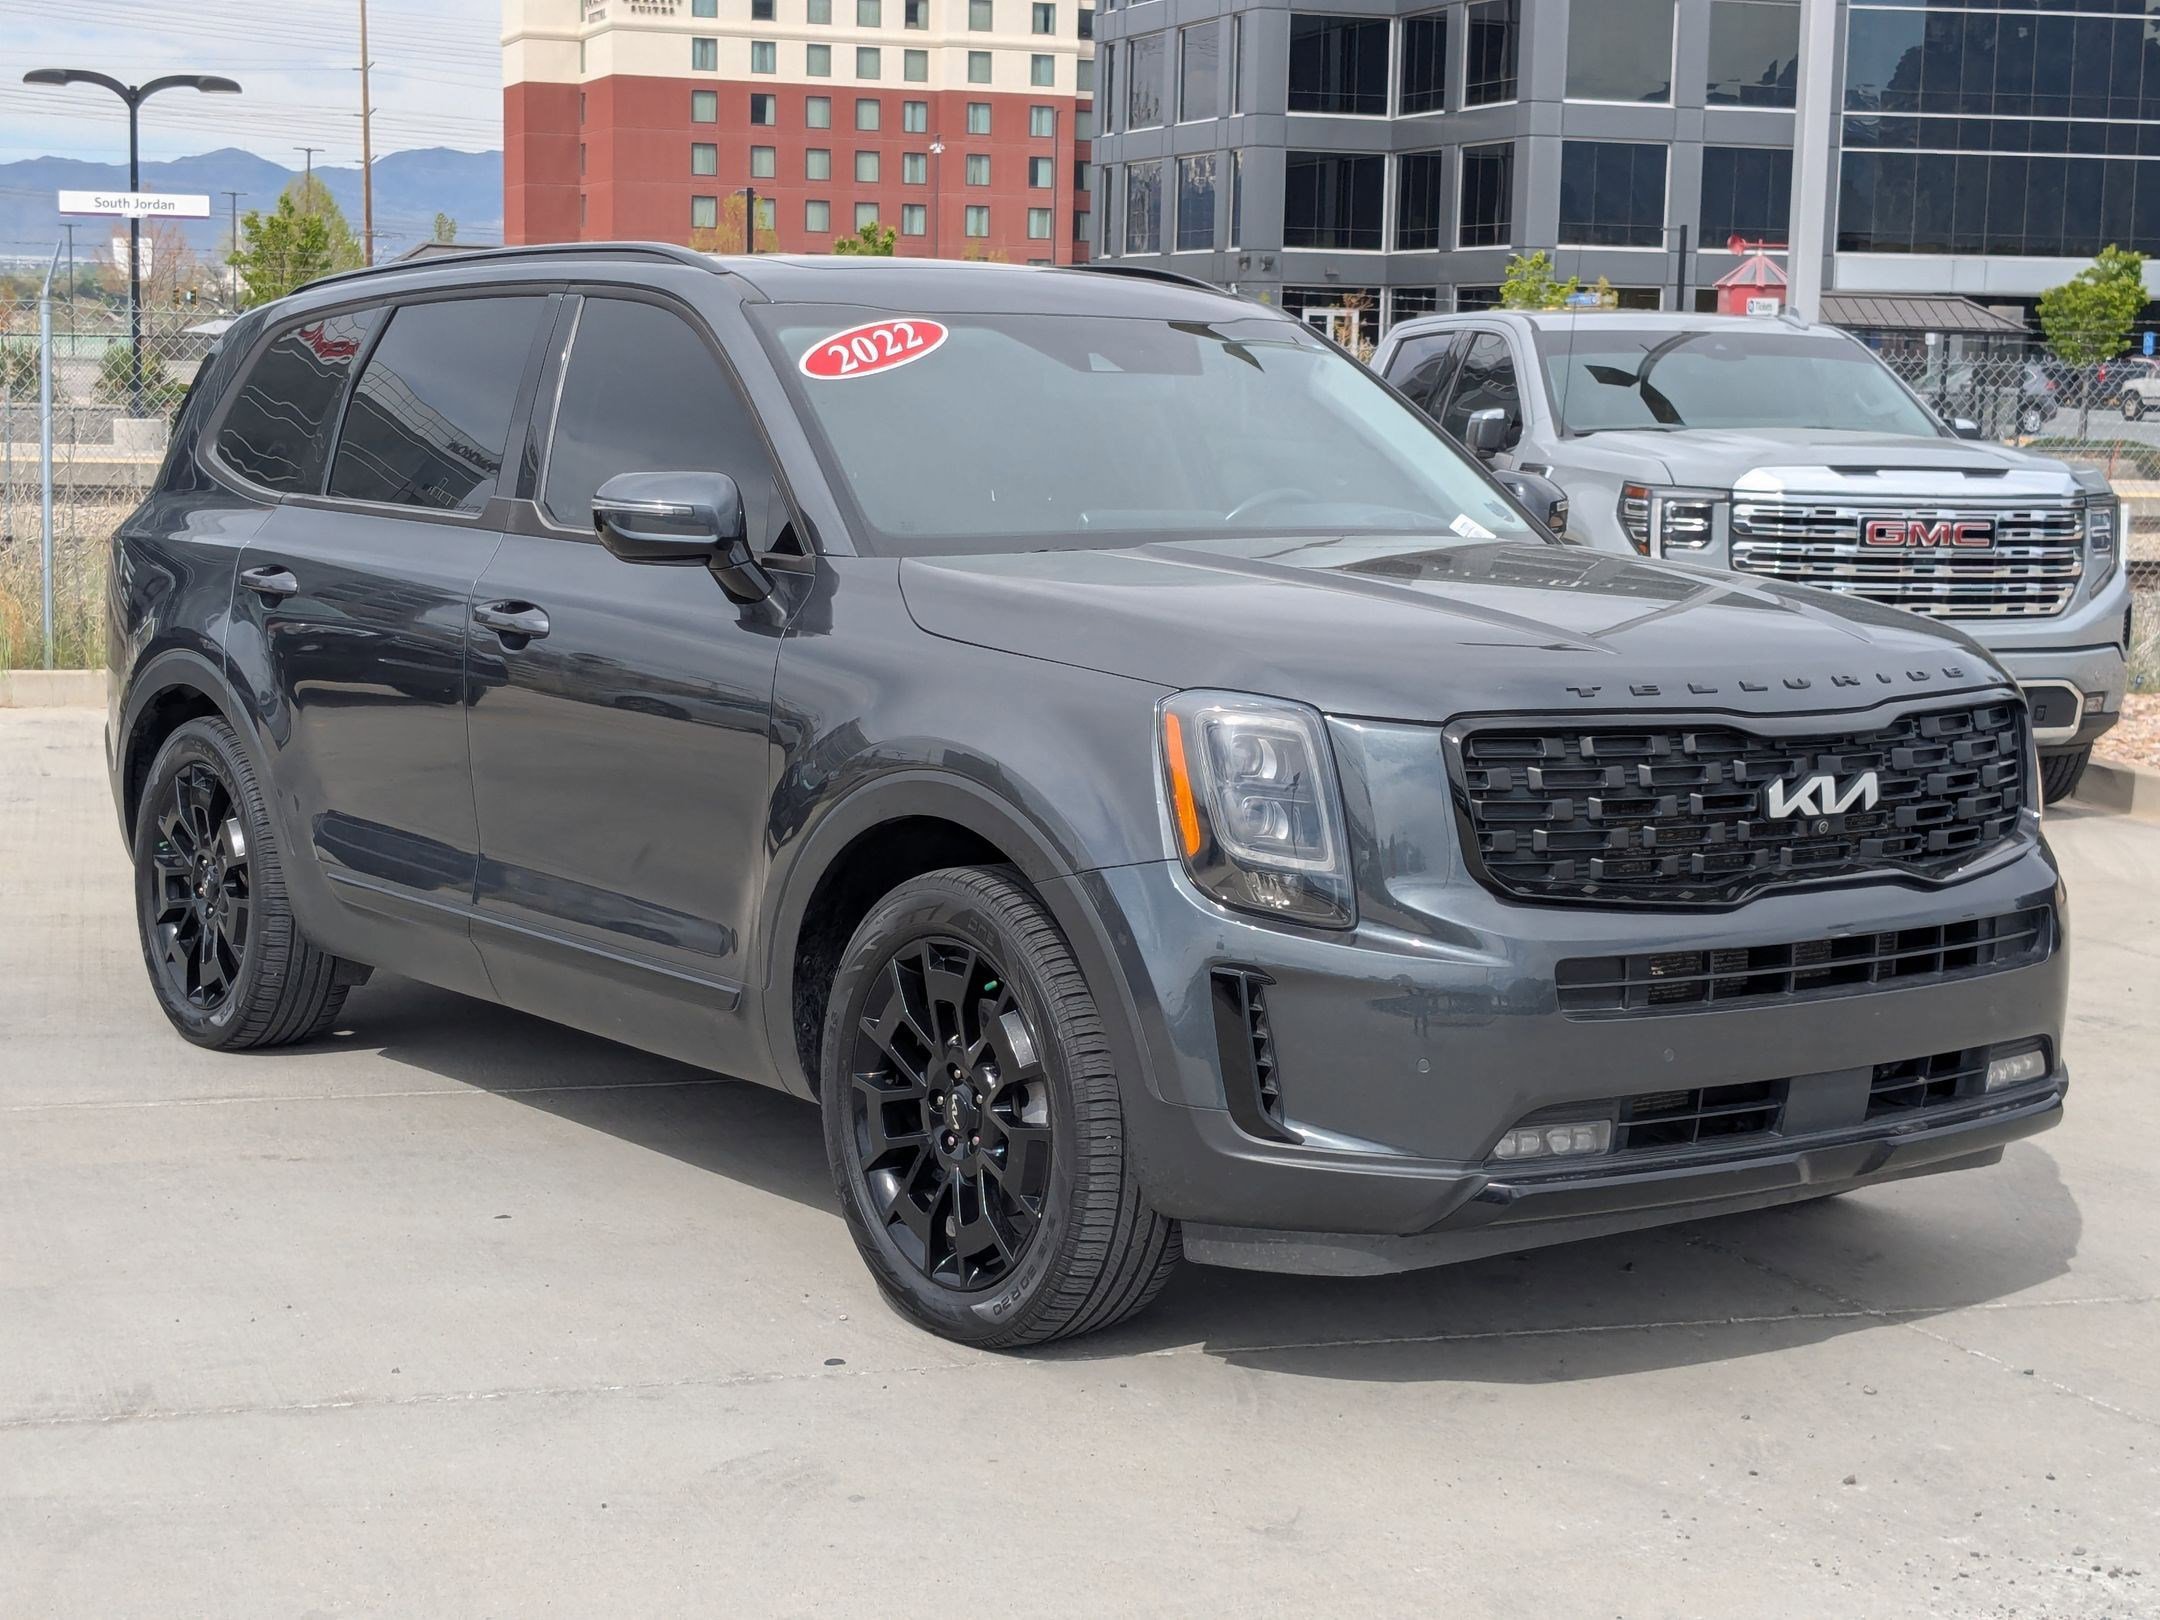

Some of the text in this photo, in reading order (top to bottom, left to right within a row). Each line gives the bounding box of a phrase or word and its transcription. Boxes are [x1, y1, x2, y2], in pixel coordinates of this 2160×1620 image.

[94, 197, 175, 210] South Jordan
[828, 322, 924, 374] 2022
[1866, 520, 1991, 547] GMC
[1566, 664, 1965, 698] TELLURIDE
[1766, 770, 1880, 820] KIA
